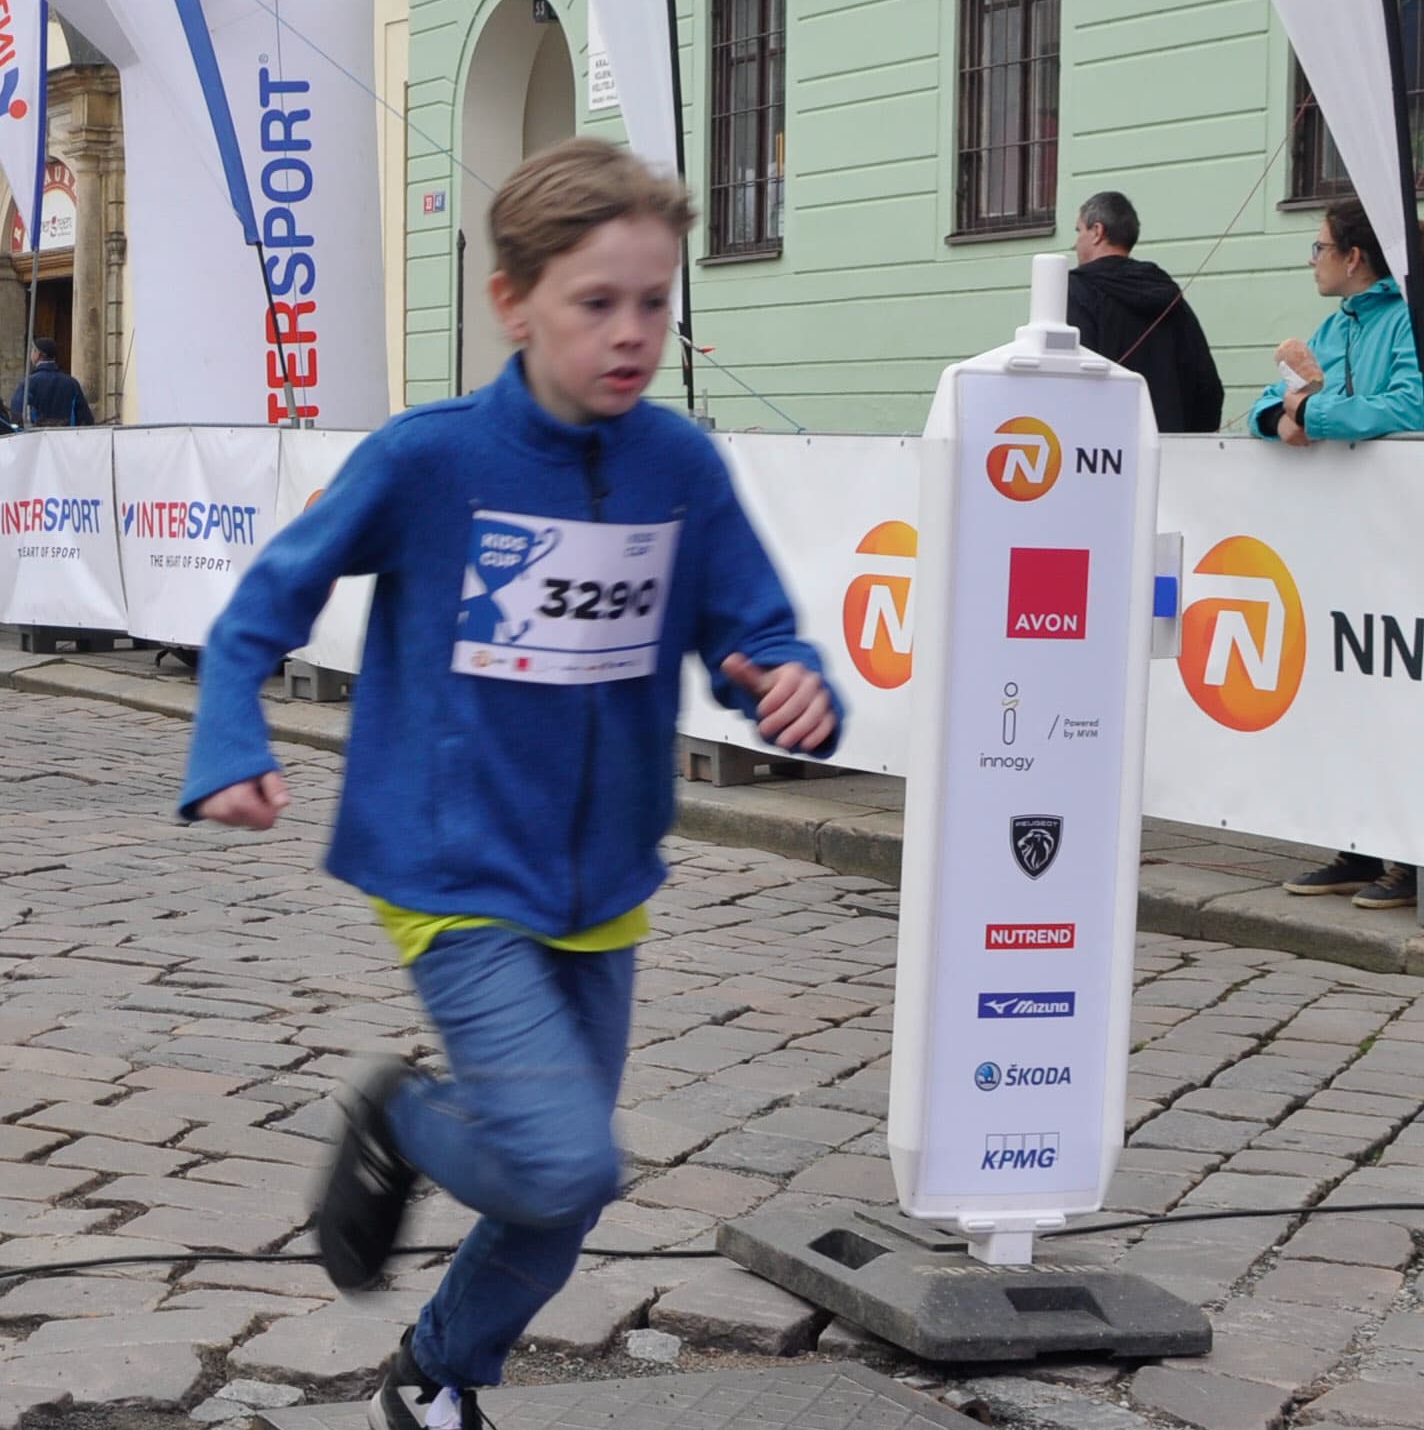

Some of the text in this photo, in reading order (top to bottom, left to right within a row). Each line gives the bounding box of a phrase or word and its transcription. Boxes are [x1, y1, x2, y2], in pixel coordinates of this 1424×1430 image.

[1075, 447, 1122, 475] NN
[1, 497, 101, 535] INTERSPORT
[136, 501, 257, 546] INTERSPORT
[51, 546, 81, 559] SPORT
[194, 556, 232, 571] SPORT
[1015, 613, 1078, 632] AVON
[1330, 610, 1424, 681] NN
[1064, 718, 1099, 728] Powered
[1063, 729, 1099, 740] by MVM
[979, 752, 1035, 772] innogy
[990, 927, 1071, 945] NUTREND
[1004, 1063, 1071, 1087] ŠKODA
[981, 1147, 1057, 1171] KPMG
